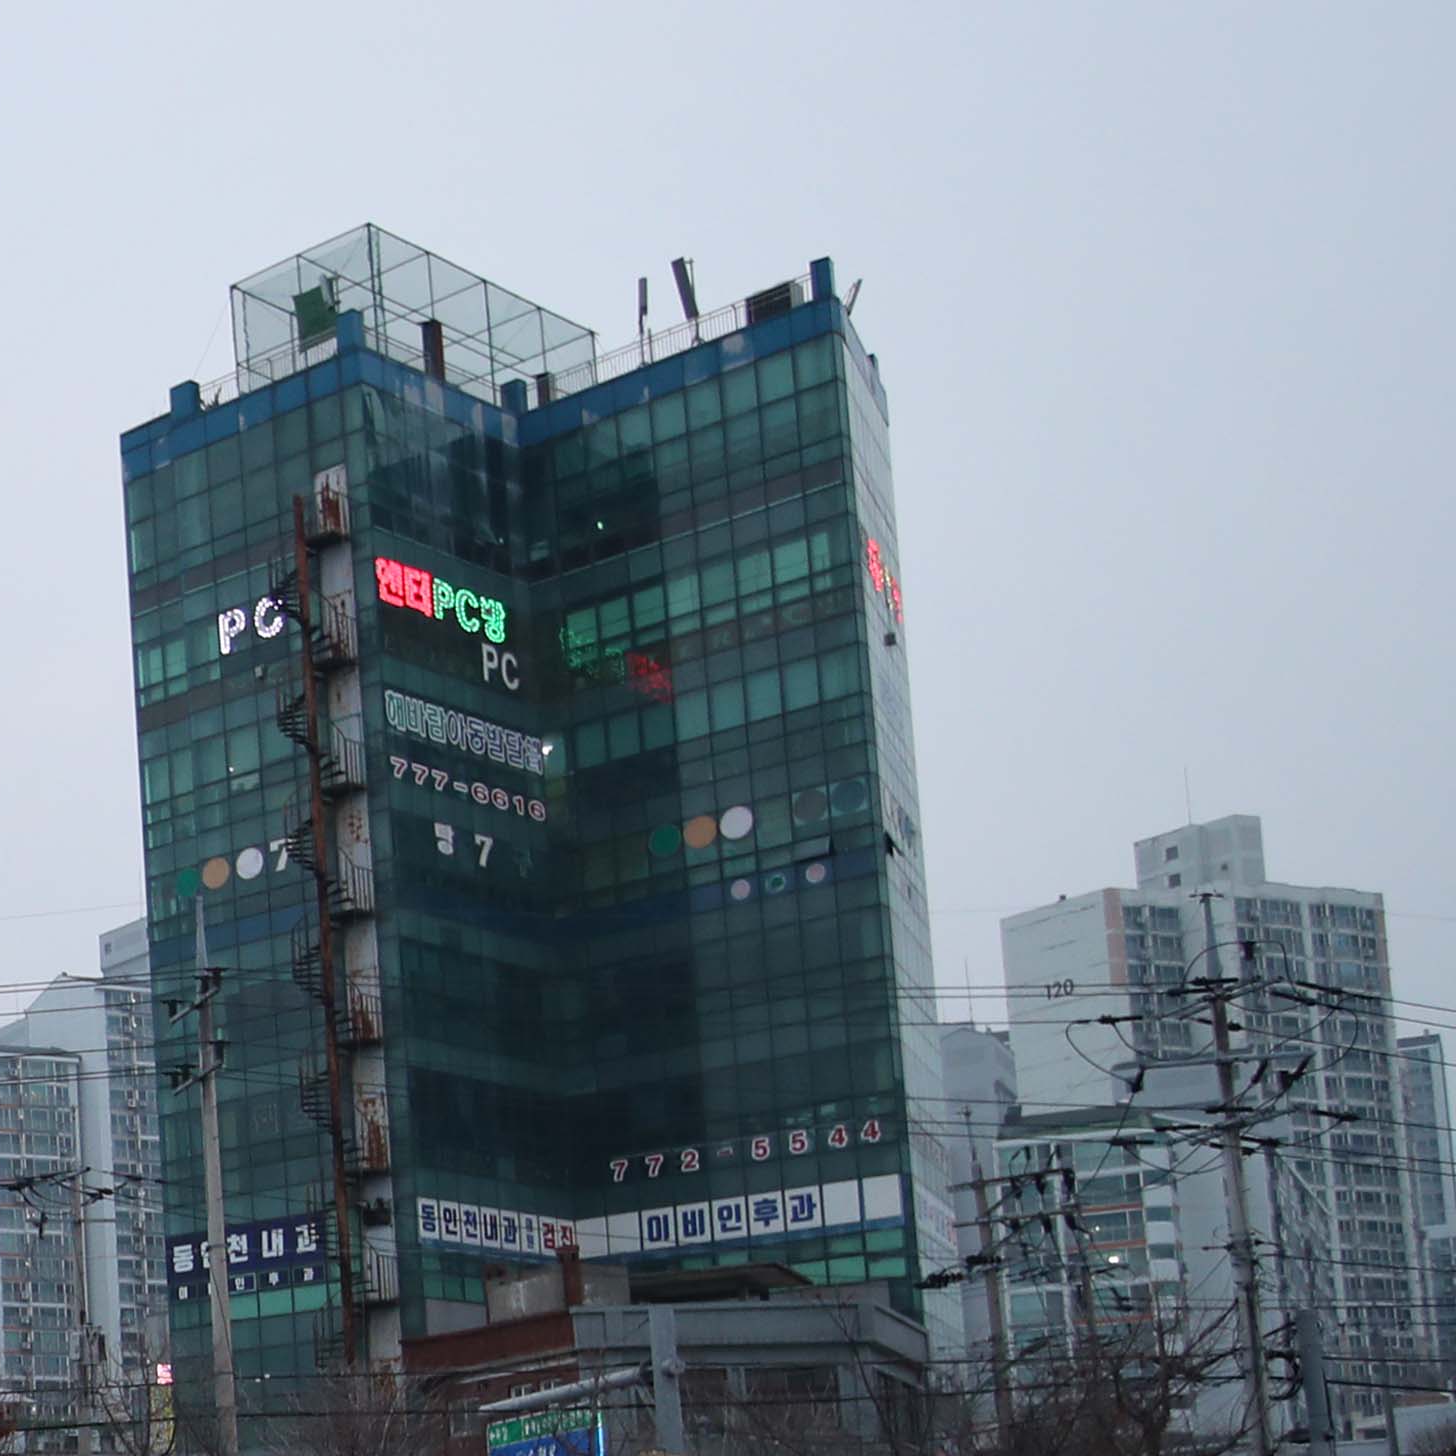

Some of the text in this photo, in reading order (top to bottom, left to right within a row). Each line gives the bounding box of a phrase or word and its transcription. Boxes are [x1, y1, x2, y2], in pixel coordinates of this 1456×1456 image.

[482, 642, 519, 690] PC
[390, 756, 546, 821] 777-6616
[1045, 978, 1074, 1001] 120
[610, 1120, 882, 1182] 772-5544
[420, 1204, 518, 1250] 동인천내과
[646, 1192, 818, 1242] 이비인후과
